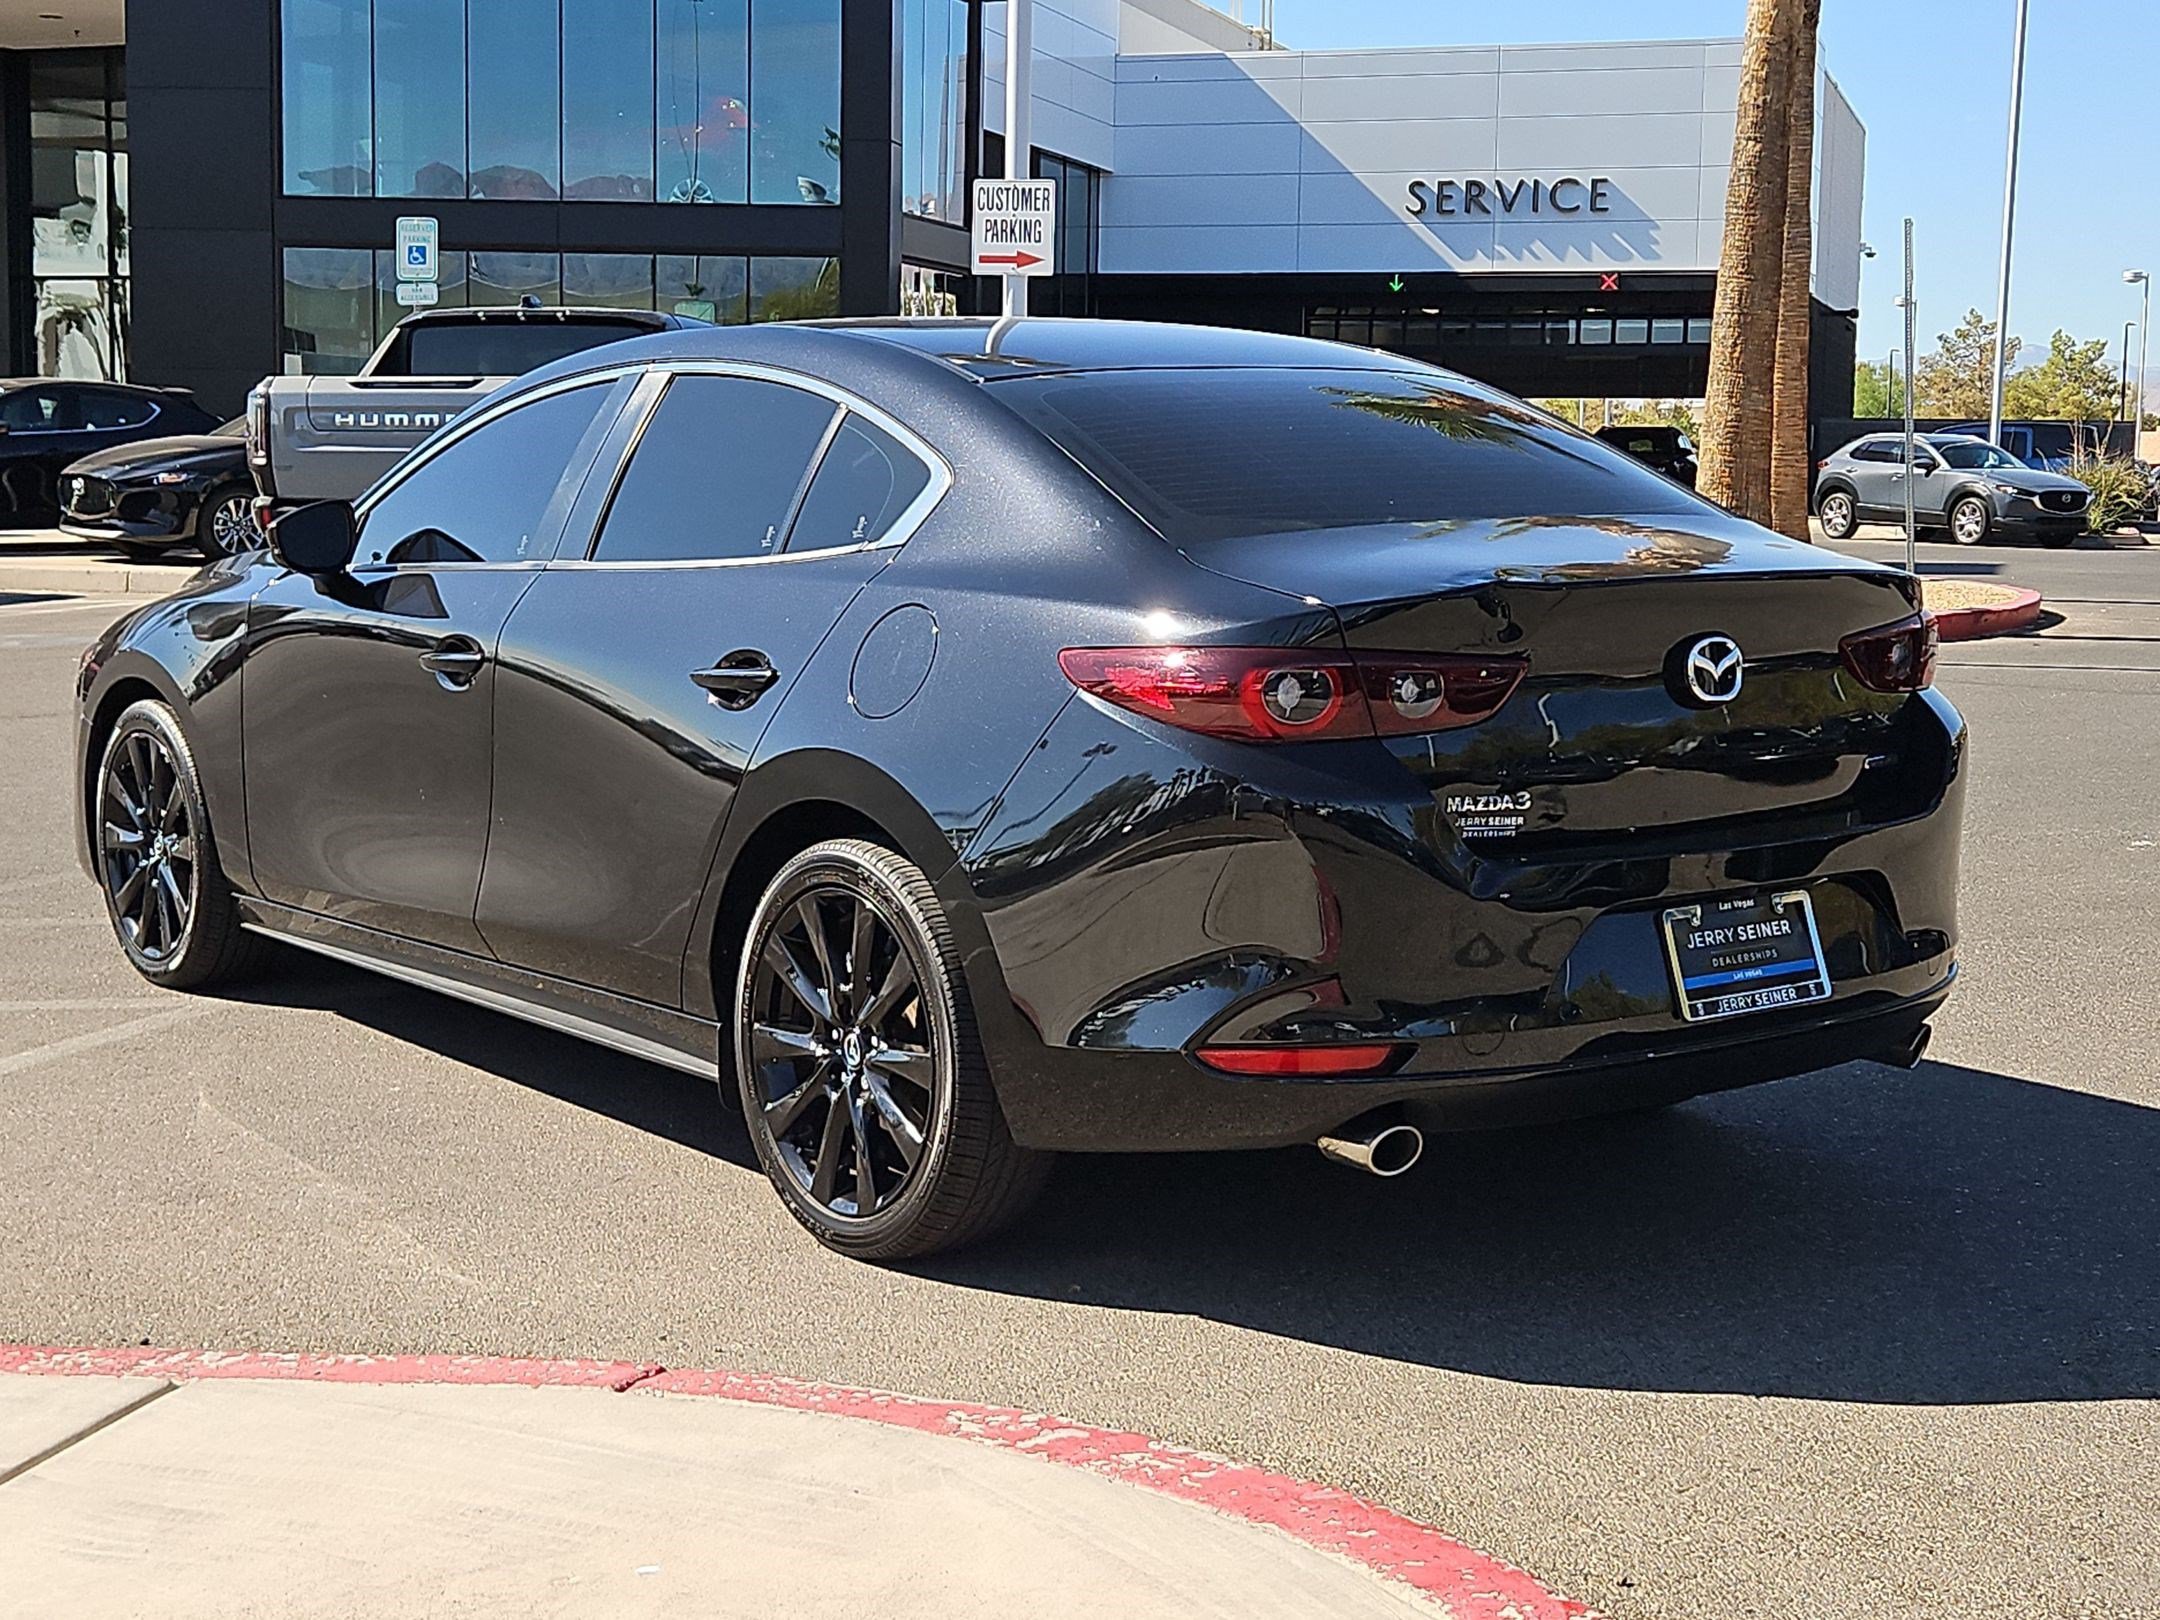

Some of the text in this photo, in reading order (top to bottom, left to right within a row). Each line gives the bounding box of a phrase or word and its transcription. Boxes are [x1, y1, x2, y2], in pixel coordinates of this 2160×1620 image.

[977, 186, 1051, 212] CUSTOMER
[1405, 177, 1610, 215] SERVICE
[984, 218, 1042, 243] PARKING
[1446, 791, 1532, 813] MAZDA3
[1455, 816, 1524, 827] JERRY SEINER
[1719, 899, 1755, 911] Las Vegas
[1687, 919, 1792, 949] JERRY SEINER
[1712, 949, 1778, 968] DEALERSHIPS
[1717, 997, 1754, 1013] JERRY
[1755, 987, 1798, 1006] SEINER
